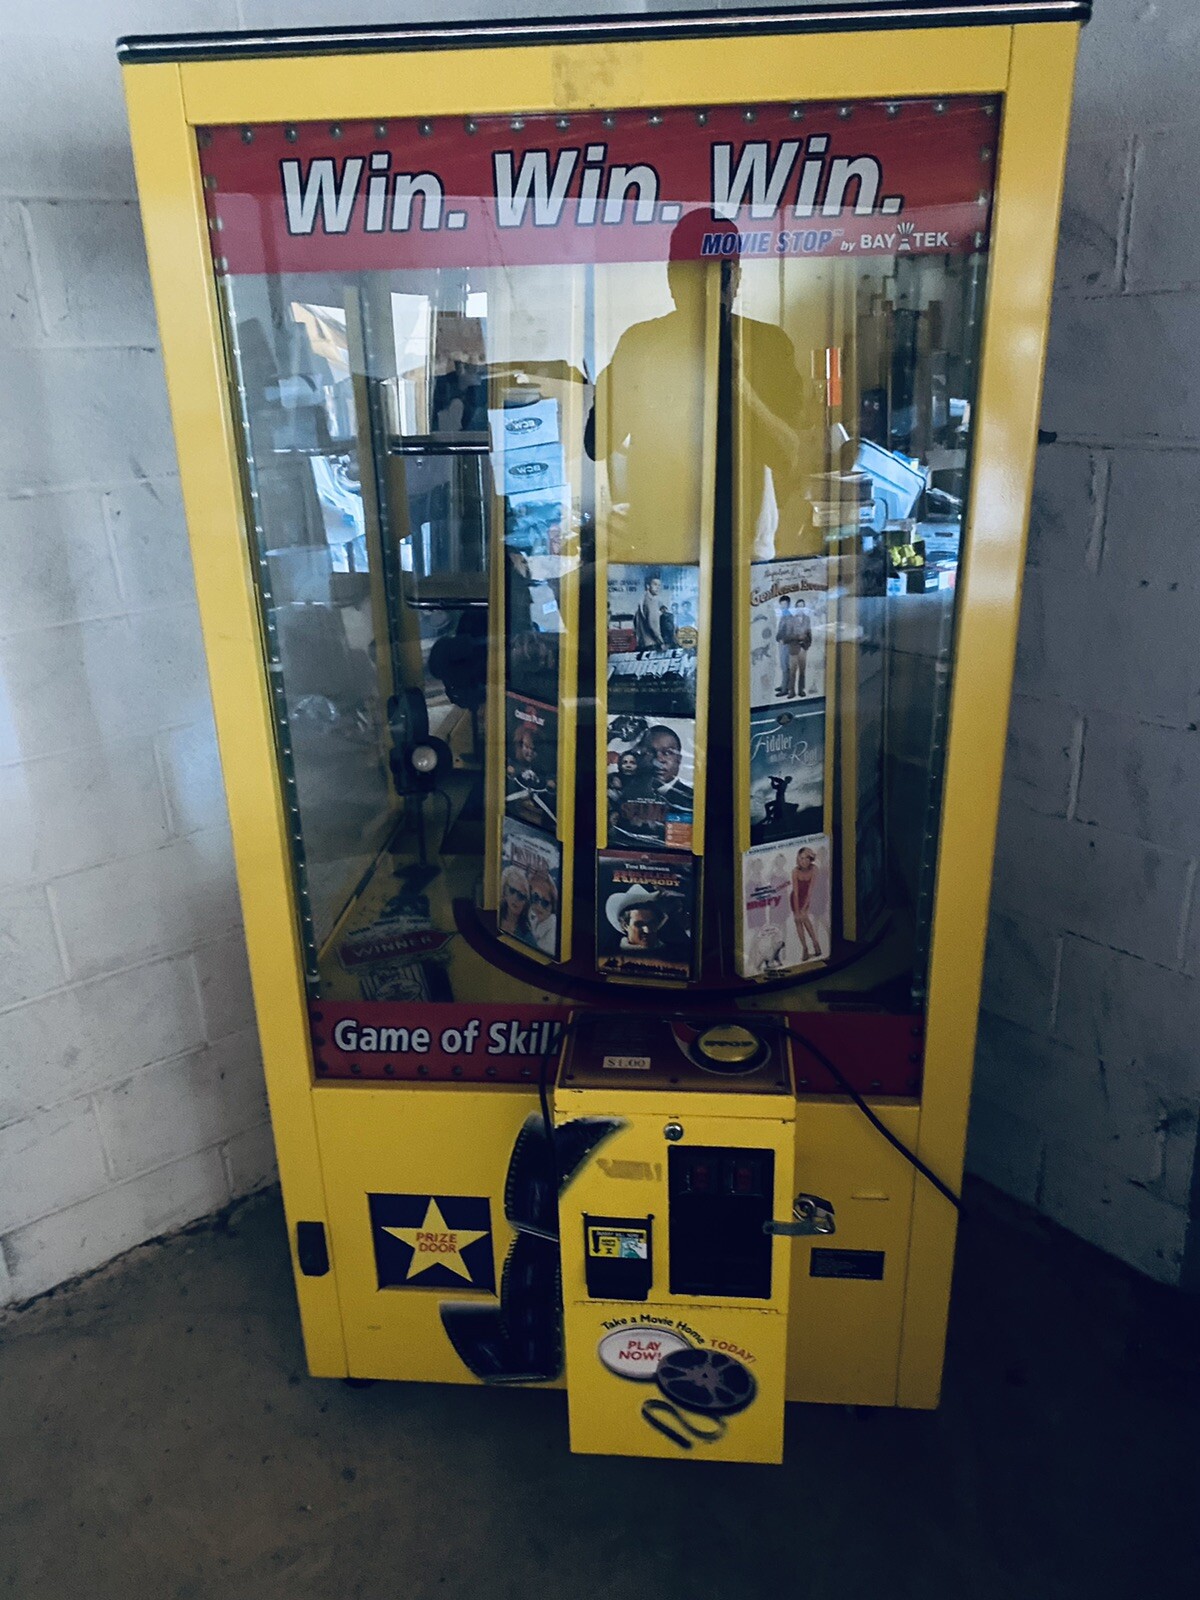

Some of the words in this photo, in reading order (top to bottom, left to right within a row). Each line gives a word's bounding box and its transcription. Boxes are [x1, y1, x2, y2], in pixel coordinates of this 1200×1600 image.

[281, 153, 466, 235] Win.
[493, 143, 682, 227] Win.
[711, 133, 904, 222] Win.
[701, 231, 771, 255] MOVIE
[840, 241, 856, 252] by
[751, 731, 793, 760] Fiddler
[334, 1019, 430, 1053] Game
[441, 1020, 480, 1054] of
[488, 1021, 562, 1054] Skill
[416, 1232, 457, 1243] PRIZE
[419, 1242, 456, 1253] DOOR
[601, 1316, 628, 1331] Take
[631, 1316, 637, 1324] a
[640, 1314, 673, 1327] Movie
[676, 1320, 706, 1344] Home
[710, 1338, 757, 1364] TODAY!
[628, 1340, 662, 1351] PLAY
[618, 1350, 662, 1362] NOW!
